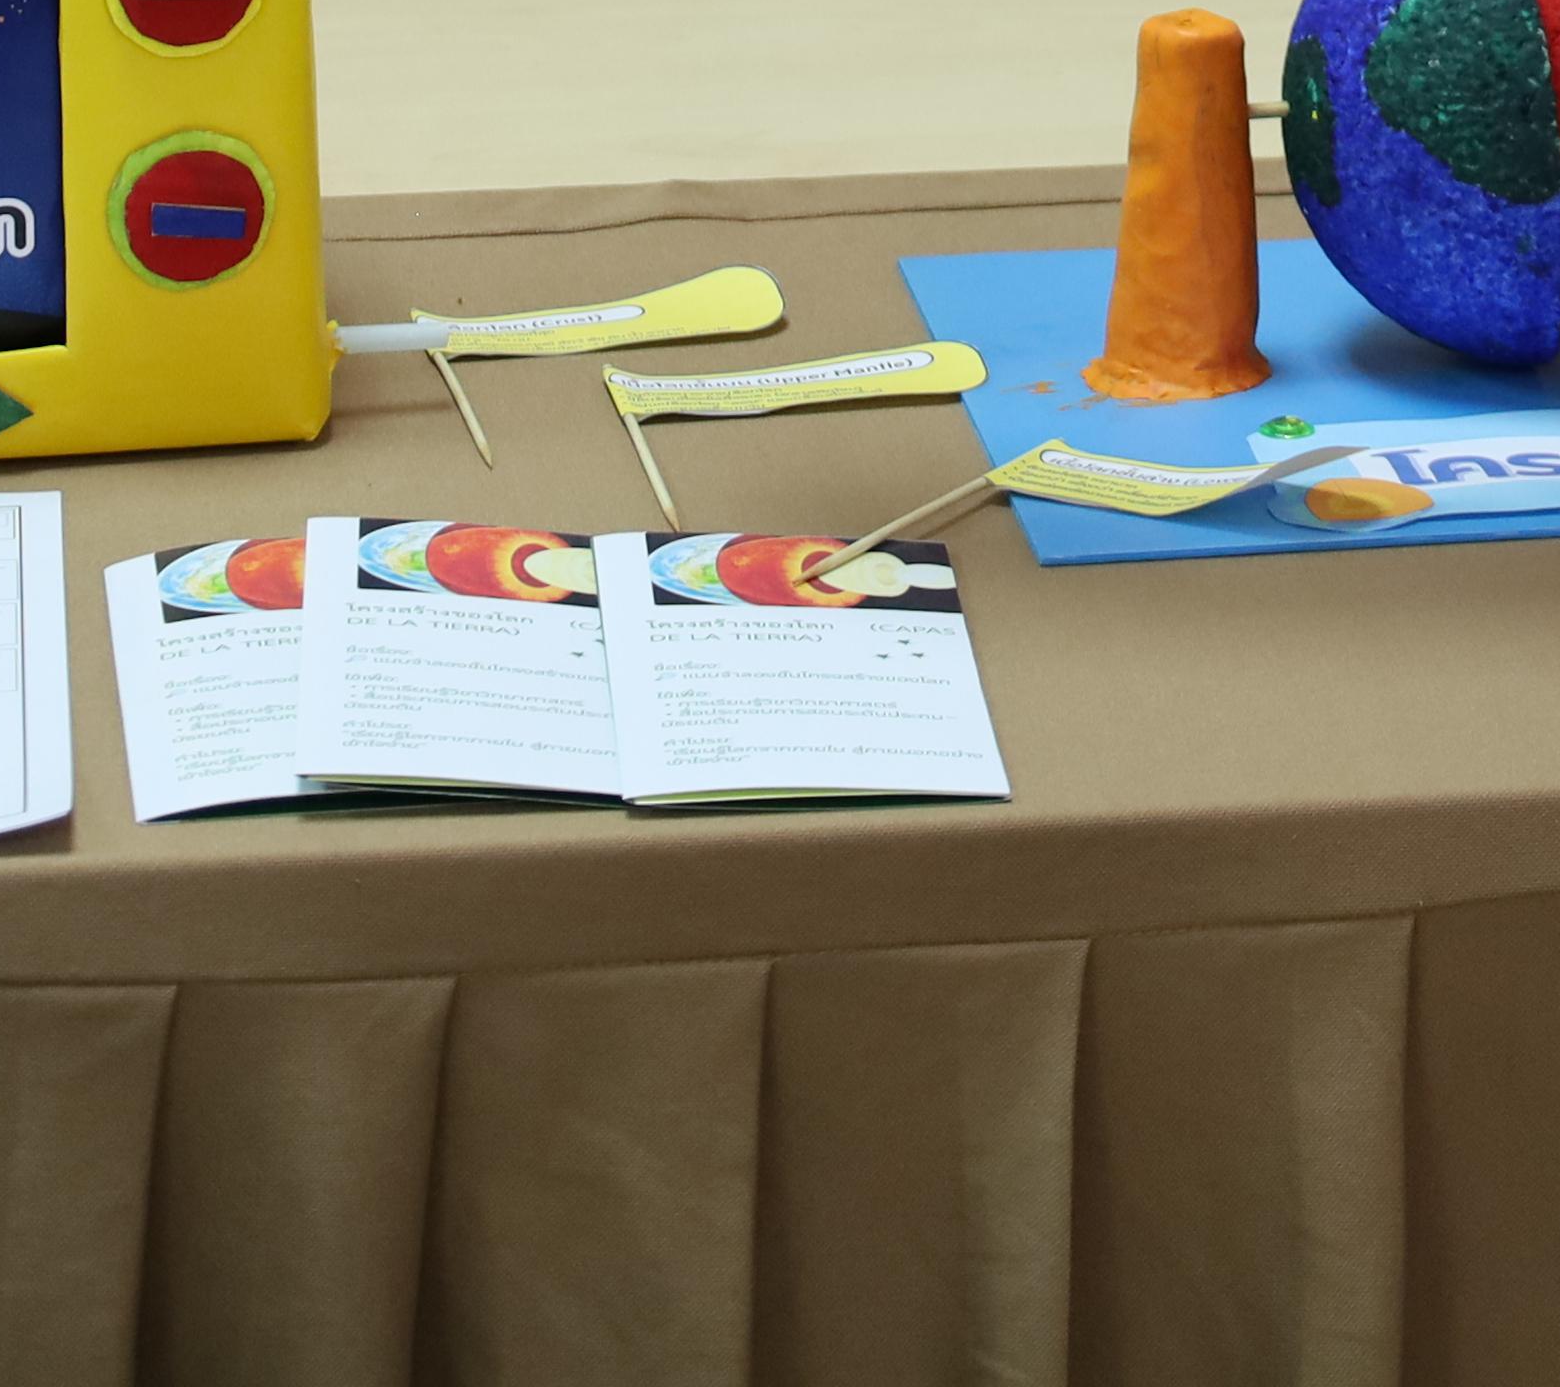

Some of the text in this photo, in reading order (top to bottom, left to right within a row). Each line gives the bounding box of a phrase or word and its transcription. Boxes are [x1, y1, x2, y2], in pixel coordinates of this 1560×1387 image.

[833, 358, 914, 377] Mantle)
[346, 616, 521, 636] DE LA TIERRA)
[869, 623, 956, 636] (CAPAS
[649, 632, 823, 643] DE LA TIERRA)
[159, 649, 191, 661] DE
[200, 643, 232, 654] LA
